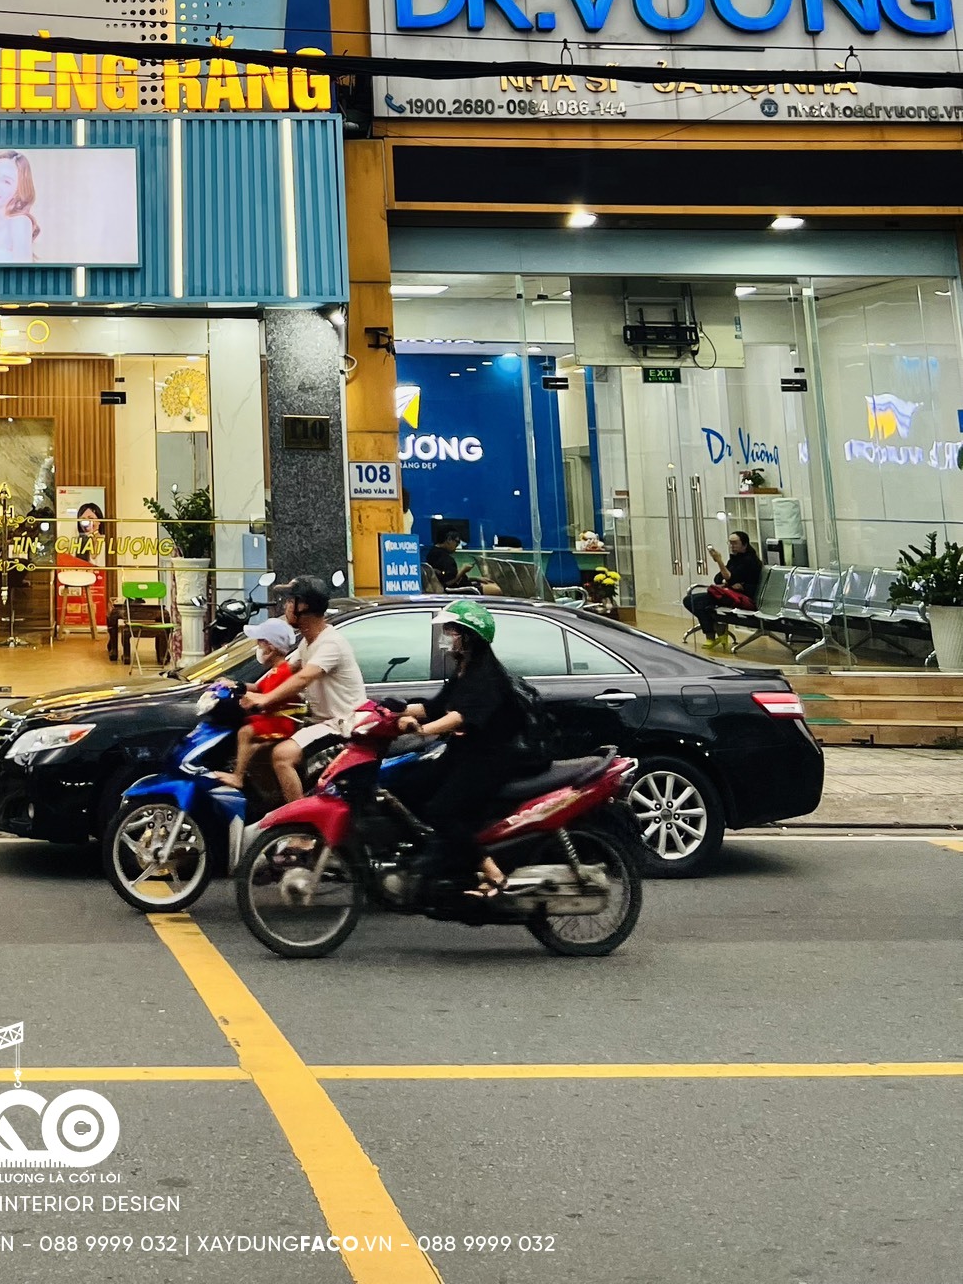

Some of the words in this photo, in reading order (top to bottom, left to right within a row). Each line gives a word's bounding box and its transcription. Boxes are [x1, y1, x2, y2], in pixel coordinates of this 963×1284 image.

[163, 35, 332, 111] RĂNG
[649, 369, 675, 377] EXIT
[355, 465, 391, 484] 108
[12, 531, 38, 554] TÍN
[54, 530, 105, 555] CHẤT
[108, 536, 175, 559] LƯỢNG
[386, 580, 401, 592] NHA
[401, 580, 420, 592] KHOA
